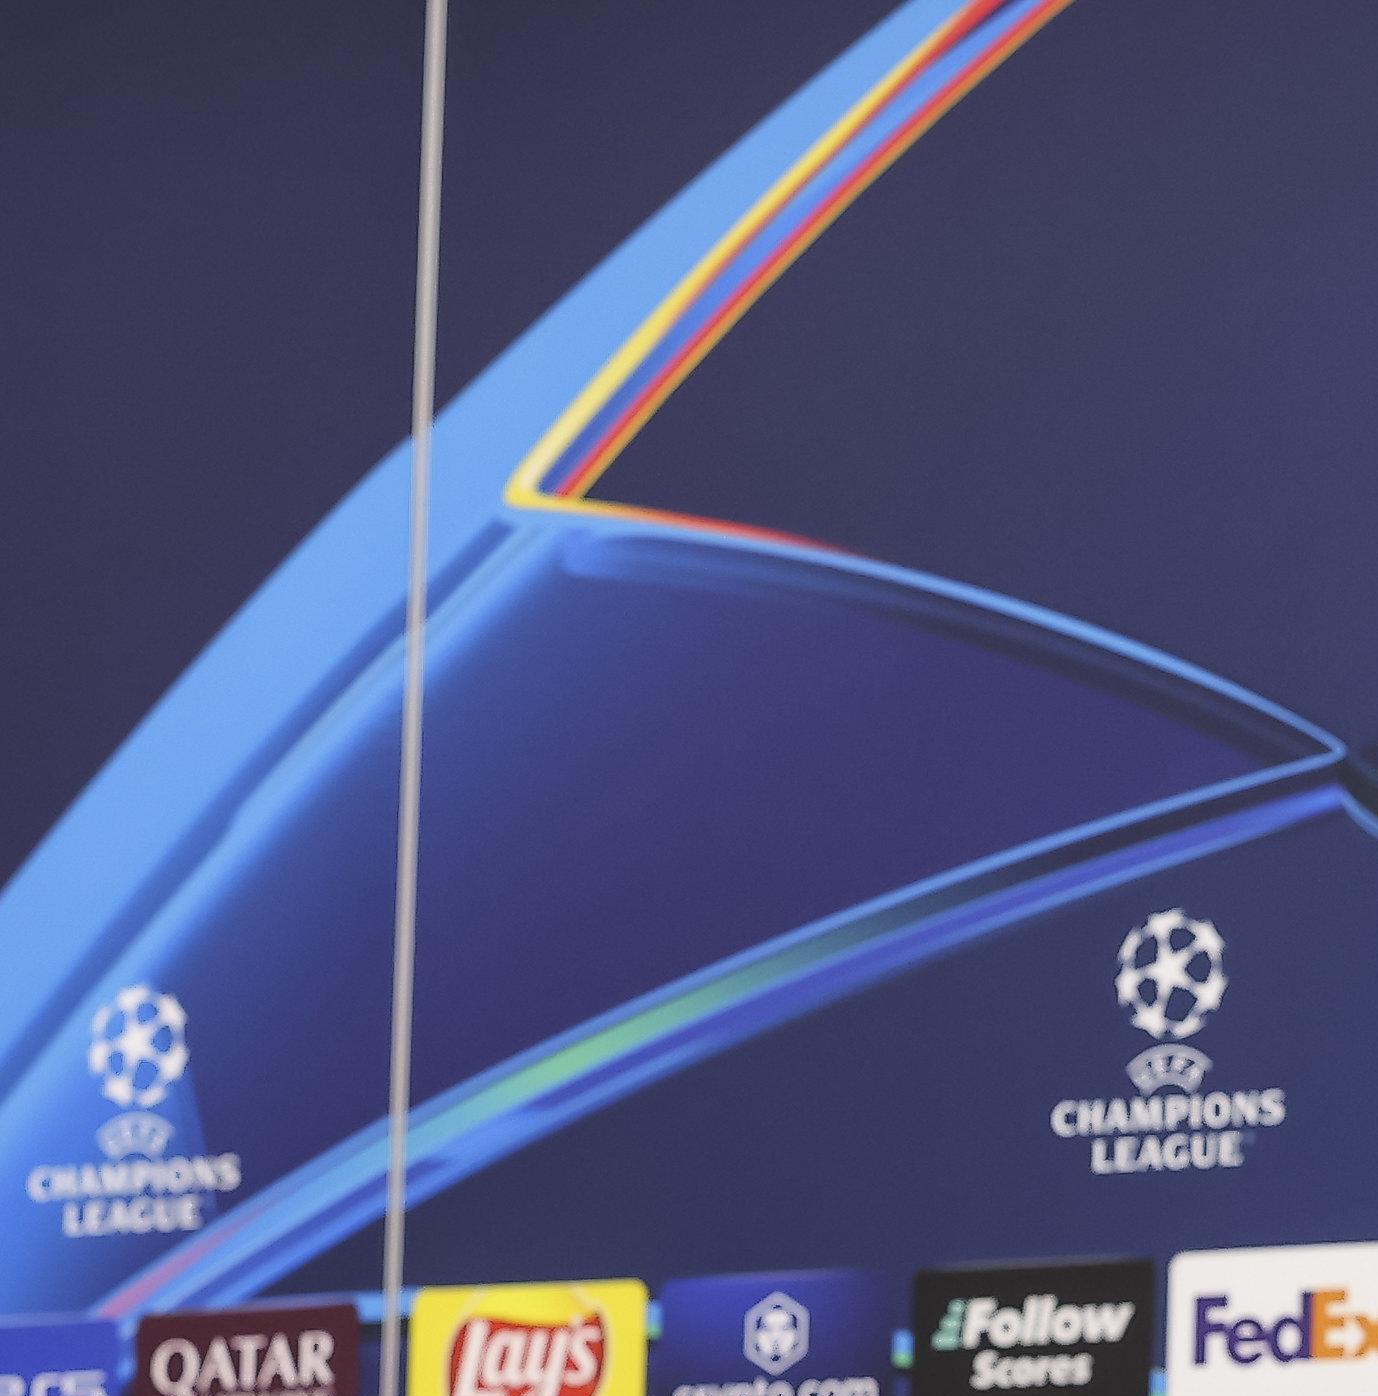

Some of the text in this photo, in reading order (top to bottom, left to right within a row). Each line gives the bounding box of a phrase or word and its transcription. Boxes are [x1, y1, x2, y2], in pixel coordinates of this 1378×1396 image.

[1050, 1087, 1287, 1138] CHAMPIONS
[1091, 1130, 1245, 1175] LEAGUE
[27, 1153, 241, 1202] CHAMPIONS
[63, 1197, 204, 1238] LEAGUE
[961, 1293, 1135, 1350] Follow
[970, 1351, 1093, 1391] Scores
